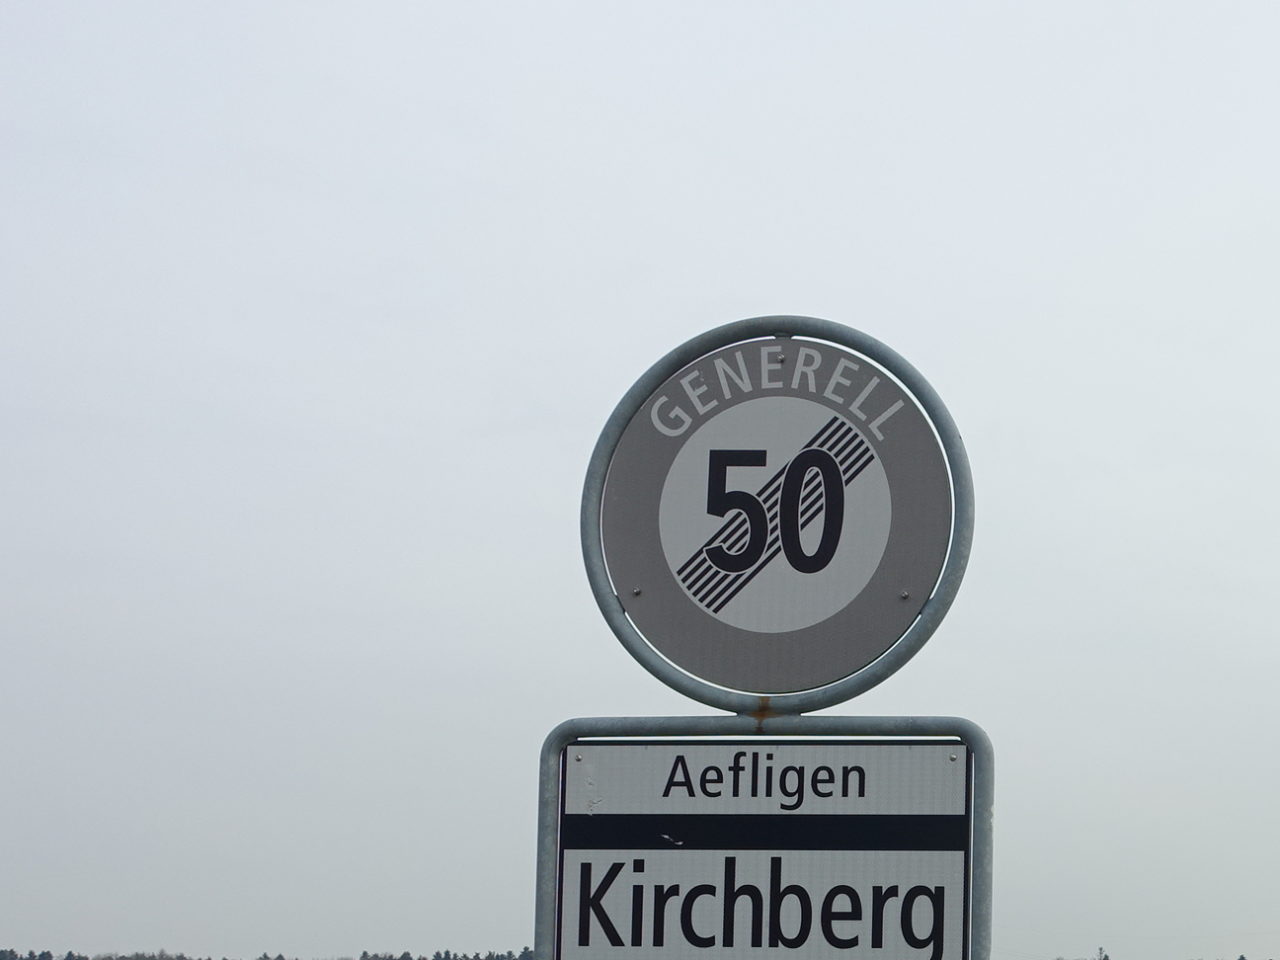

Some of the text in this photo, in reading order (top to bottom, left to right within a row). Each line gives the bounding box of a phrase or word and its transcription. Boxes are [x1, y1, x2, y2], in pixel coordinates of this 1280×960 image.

[650, 345, 905, 441] GENERELL
[703, 447, 846, 574] 50
[662, 752, 867, 810] Aefligen
